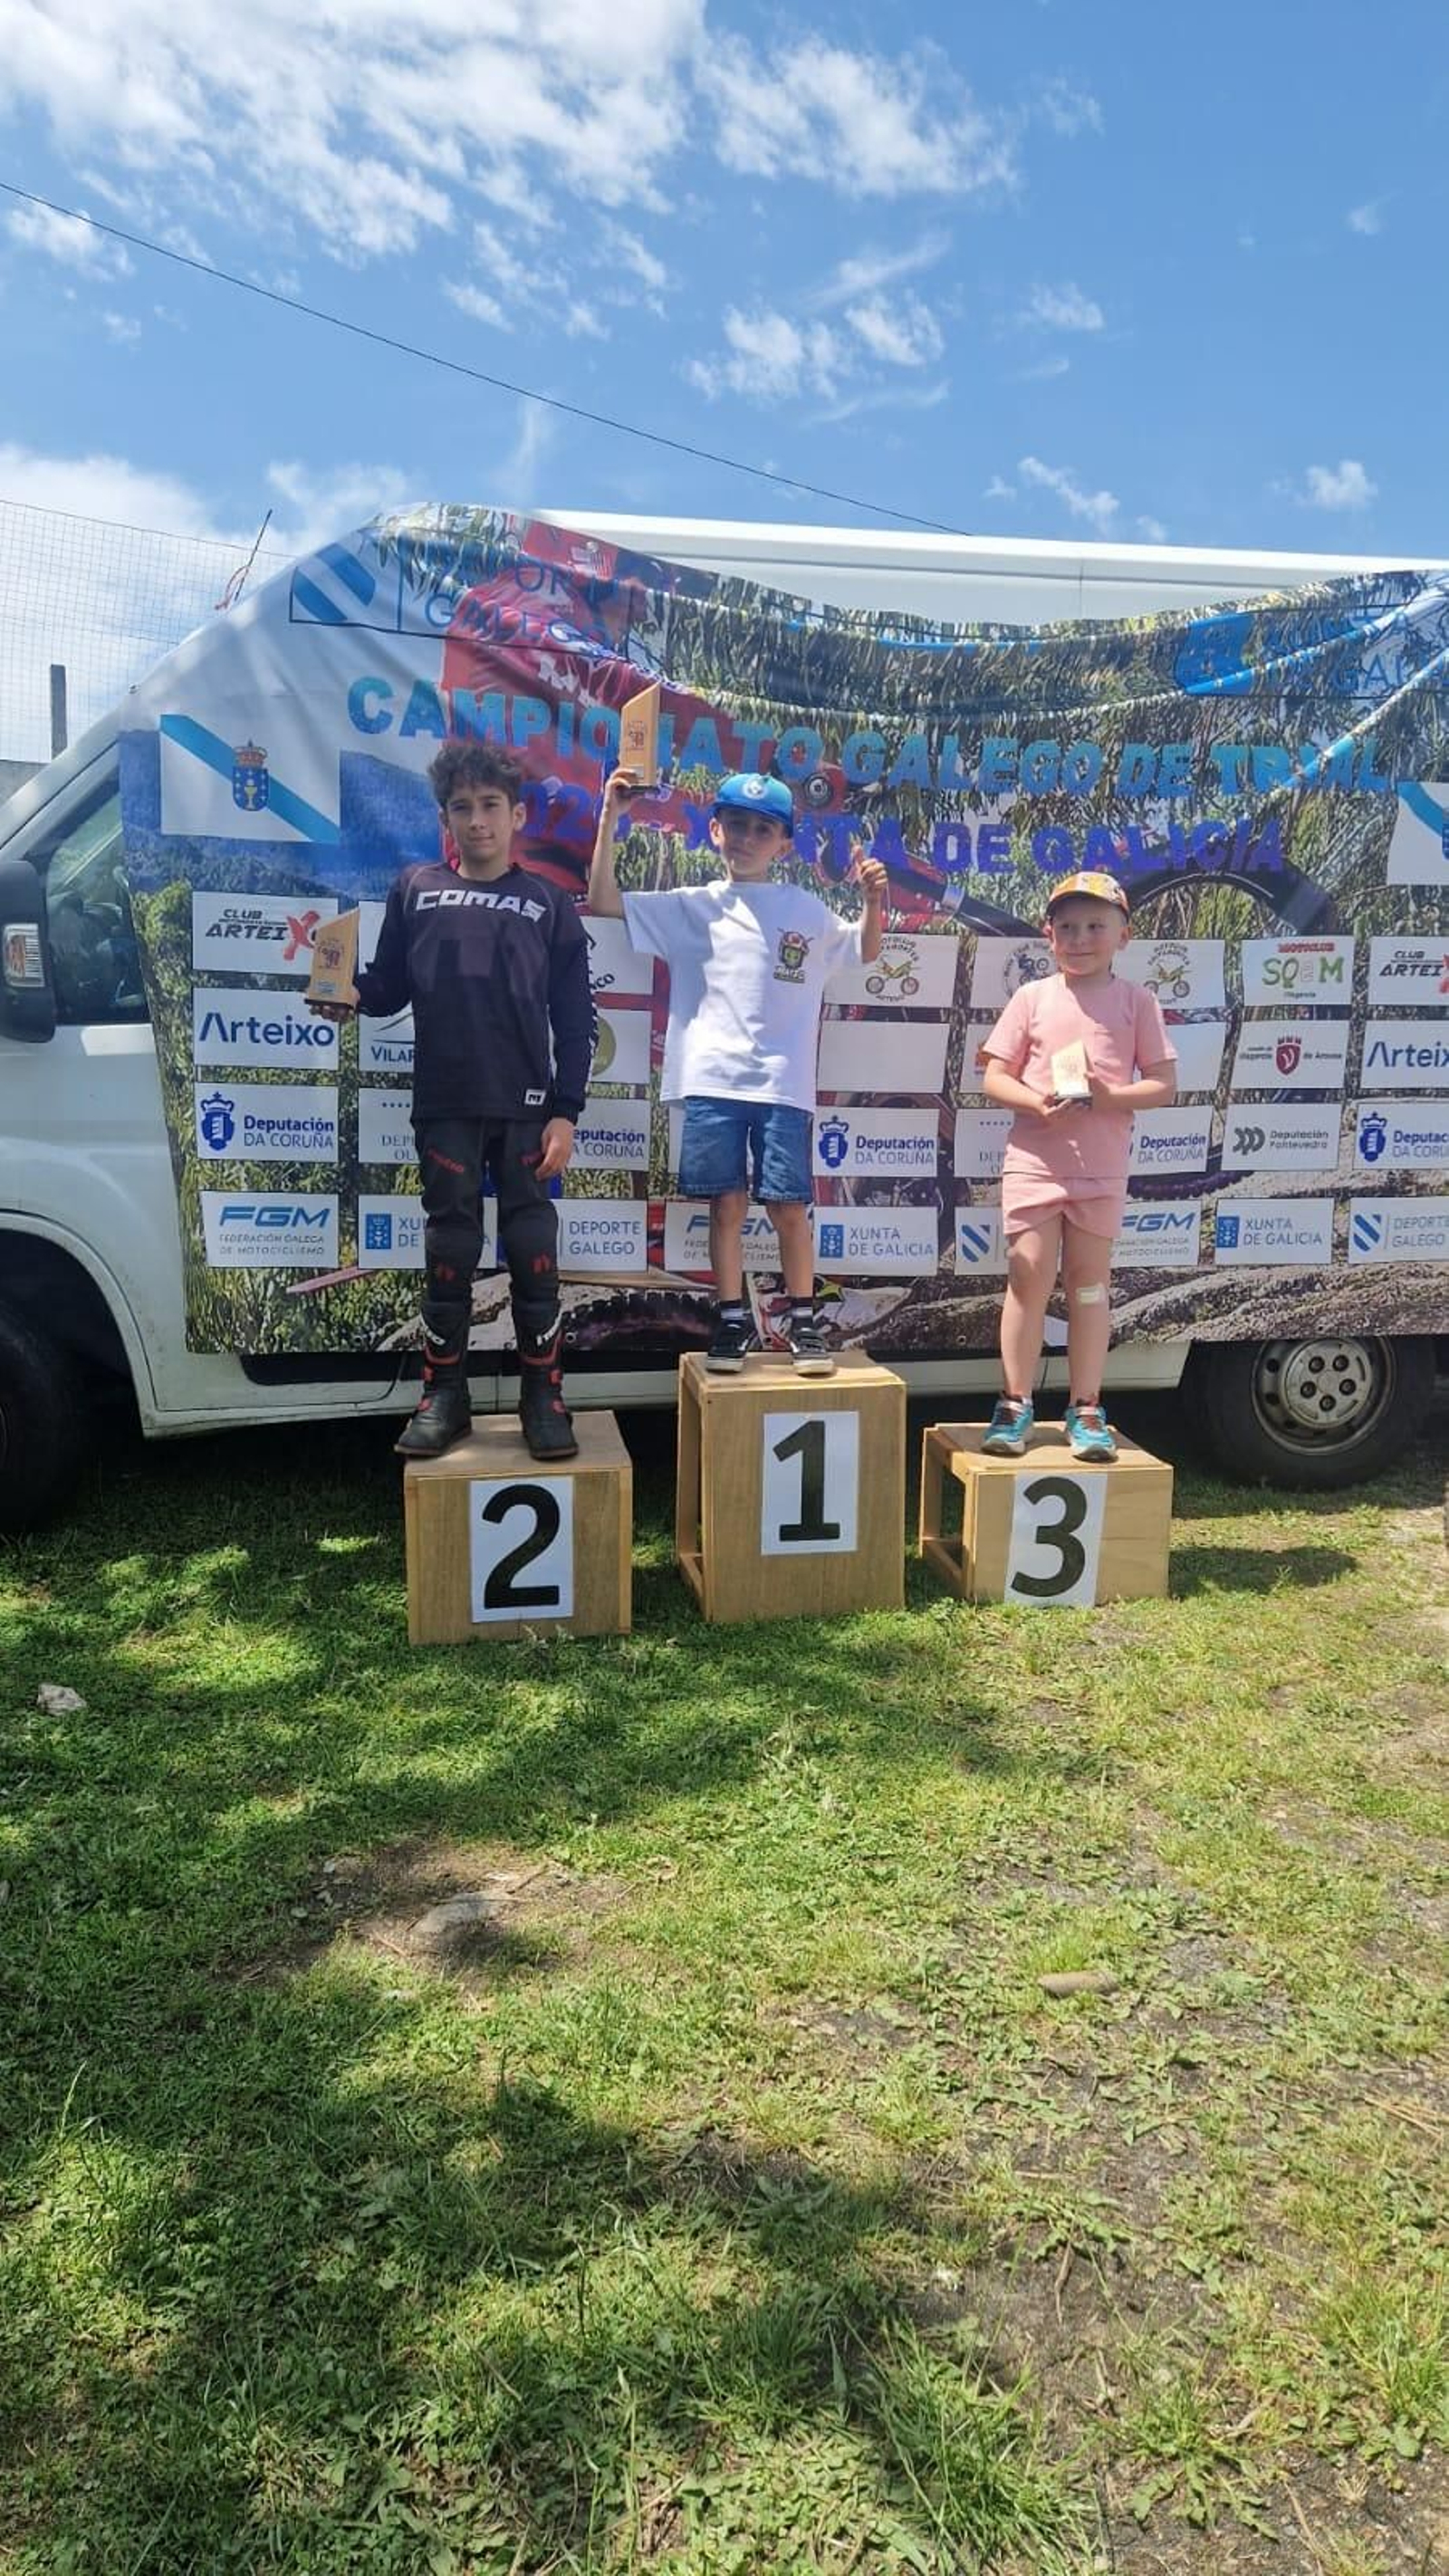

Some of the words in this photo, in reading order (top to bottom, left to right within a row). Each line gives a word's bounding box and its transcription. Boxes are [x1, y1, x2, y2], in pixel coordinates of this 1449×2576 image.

[842, 730, 1103, 797] GALEGO
[1115, 742, 1191, 797] DE
[932, 822, 1014, 873] DE
[1031, 816, 1283, 873] GALICIA
[223, 908, 263, 919] CLUB
[416, 889, 547, 922] COMAS
[206, 909, 320, 961] ARTEIX
[1395, 950, 1425, 959] CLUB
[199, 1013, 334, 1046] Arteixo
[244, 1115, 334, 1132] Deputación
[244, 1132, 265, 1147] DA
[573, 1129, 646, 1144] eputación
[856, 1135, 934, 1151] Deputación
[1140, 1133, 1206, 1149] Deputación
[856, 1151, 873, 1165] DA
[1137, 1149, 1155, 1164] DA
[220, 1206, 330, 1227] FGM
[1246, 1217, 1293, 1230] XUNTA
[570, 1220, 640, 1235] DEPORTE
[850, 1227, 900, 1240] XUNTA
[398, 1234, 418, 1247] DE
[1243, 1233, 1265, 1245] DE
[1271, 1232, 1322, 1245] GALICIA
[570, 1239, 635, 1255] GALEGO
[849, 1243, 869, 1255] DE
[873, 1244, 934, 1255] GALICIA
[773, 1419, 840, 1543] 1
[1011, 1475, 1088, 1597] 3
[482, 1483, 561, 1609] 2
